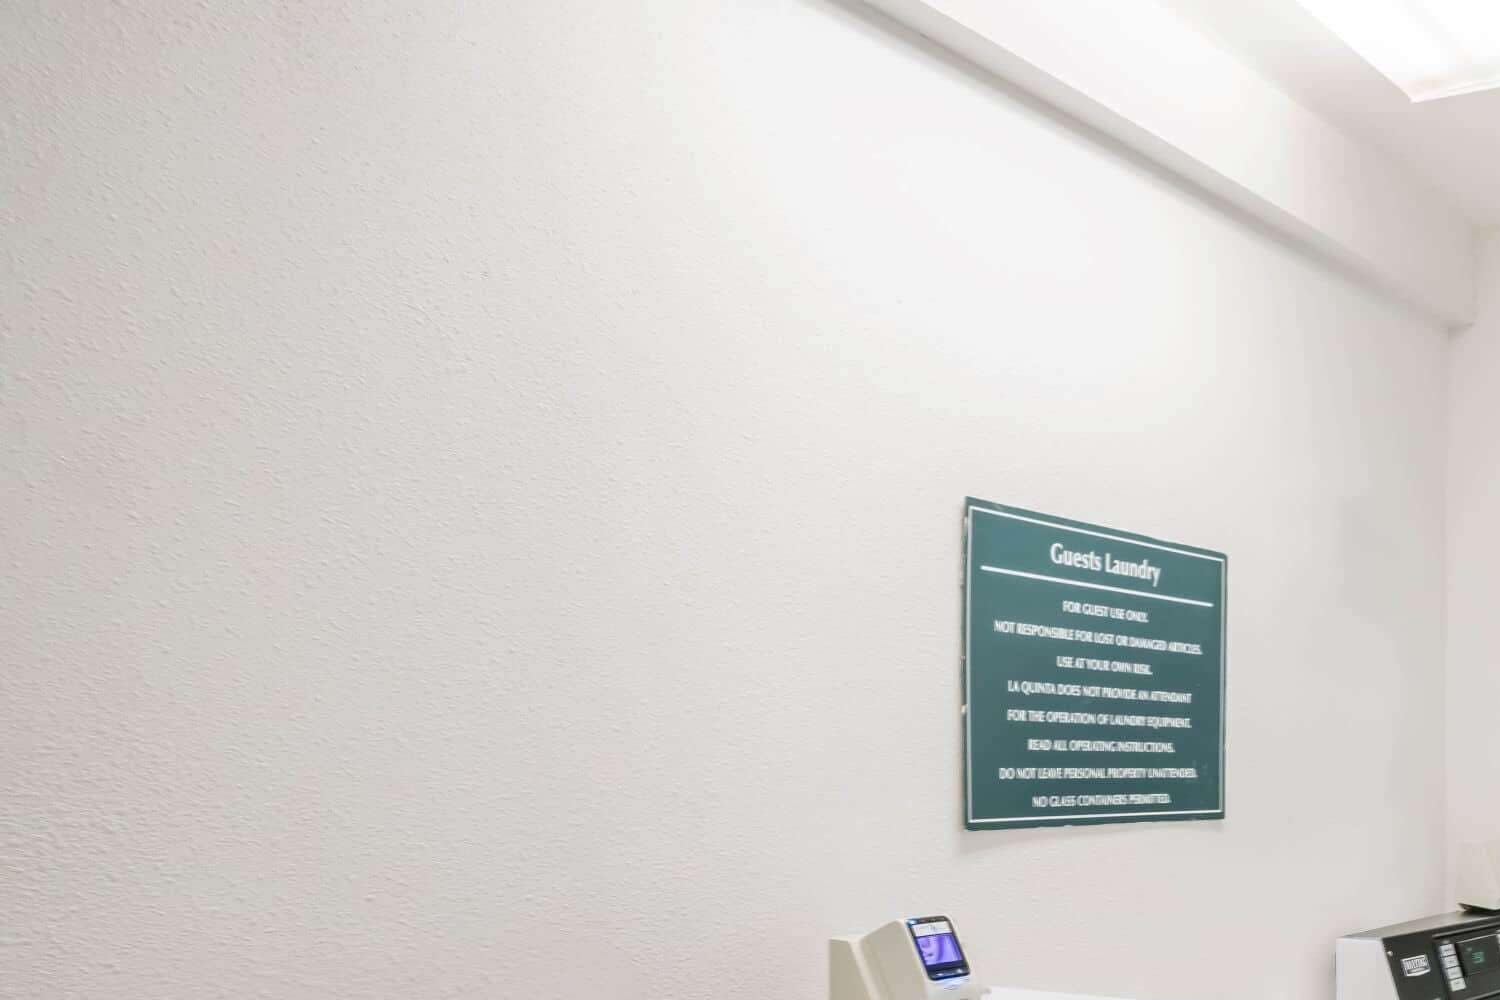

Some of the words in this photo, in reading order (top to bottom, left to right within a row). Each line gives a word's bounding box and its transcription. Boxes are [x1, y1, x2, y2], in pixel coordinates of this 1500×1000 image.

[1050, 542, 1102, 571] Guests
[1105, 552, 1161, 588] Laundry
[1062, 600, 1081, 614] FOR
[1082, 603, 1109, 617] GUEST
[993, 619, 1015, 634] NOT
[1016, 622, 1074, 641] RESPONSIBLE
[1075, 630, 1093, 642] FOR
[1094, 632, 1115, 645] LOST
[1115, 635, 1128, 647] OR
[1056, 655, 1074, 668] USE
[1086, 659, 1110, 671] YOUR
[1111, 661, 1132, 673] OWN
[1007, 680, 1020, 692] LA
[1021, 681, 1056, 696] QUINTA
[1056, 683, 1081, 696] DOES
[1082, 685, 1101, 697] NOT
[1007, 709, 1026, 721] FOR
[1027, 710, 1046, 722] THE
[1046, 711, 1097, 725] OPERATION
[1097, 713, 1110, 725] OF
[1027, 738, 1052, 751] READ
[999, 767, 1016, 779] DO
[1016, 767, 1037, 779] NOT
[1032, 795, 1049, 808] NO
[1049, 795, 1077, 807] GLASS
